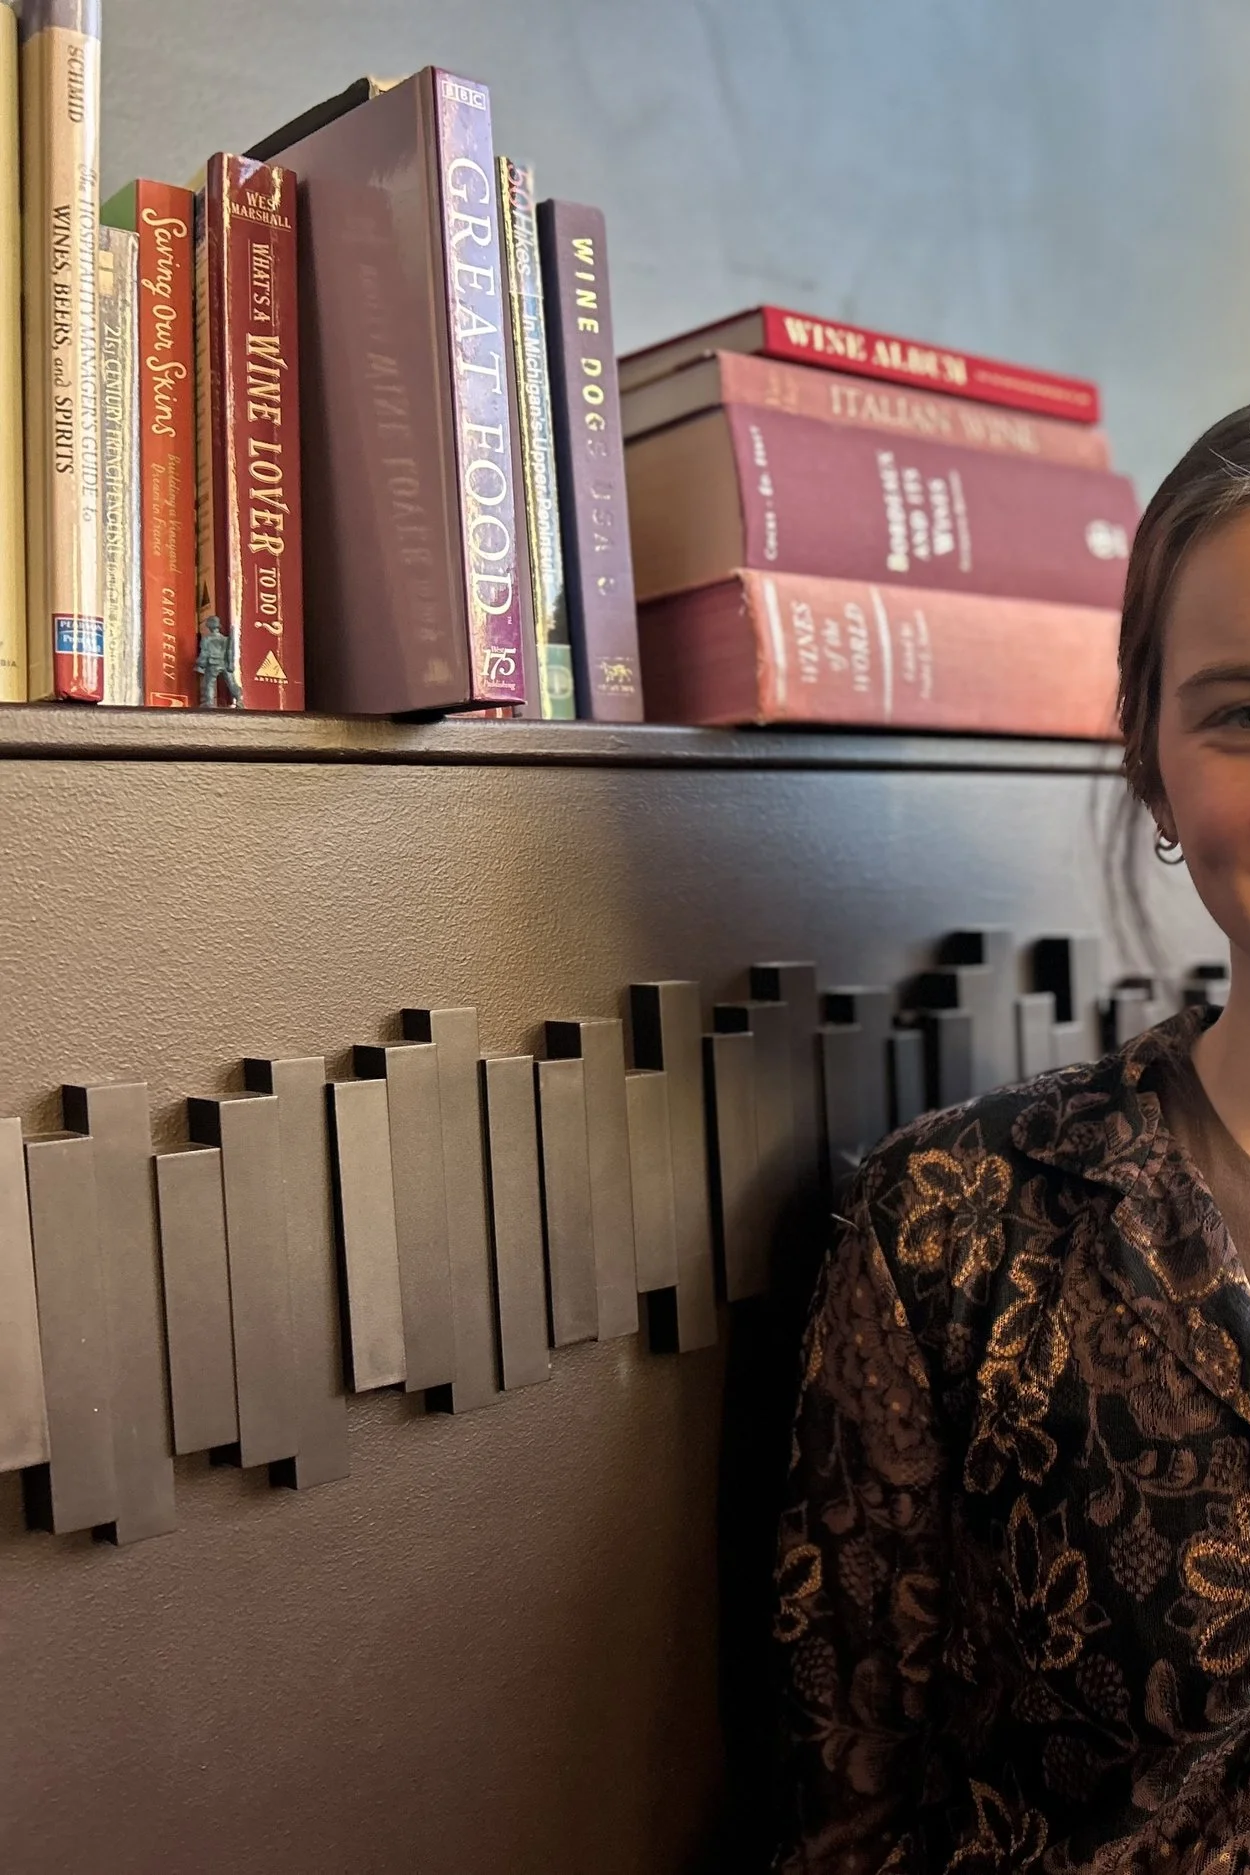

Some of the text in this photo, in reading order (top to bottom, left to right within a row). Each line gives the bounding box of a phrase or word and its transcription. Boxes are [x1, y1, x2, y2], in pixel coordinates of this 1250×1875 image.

[67, 44, 85, 124] SCHMID
[445, 82, 485, 108] BBC
[231, 202, 292, 229] MARSHALL
[508, 163, 534, 211] 50
[78, 199, 97, 322] HOSPITALITY
[252, 242, 272, 307] WHAT'S
[449, 157, 502, 394] GREAT
[511, 209, 537, 276] Hikes
[253, 310, 271, 323] A
[571, 237, 599, 335] WINE
[53, 204, 74, 474] WINES, BEERS, and SPIRITS
[141, 207, 187, 438] Saving Our Skins
[783, 315, 969, 386] WINE ALBUM
[79, 323, 98, 432] MANAGER'S
[104, 358, 122, 426] CENTURY
[246, 332, 288, 426] WINE
[523, 334, 546, 433] Michigan's
[580, 356, 608, 458] DOGS
[829, 383, 953, 435] ITALIAN
[957, 409, 1041, 454] WINE
[81, 436, 98, 497] GUIDE
[151, 463, 166, 501] Dream
[166, 453, 181, 511] Building
[247, 436, 291, 557] LOVER
[530, 436, 550, 493] Upper
[82, 506, 99, 522] to
[152, 516, 166, 556] France
[167, 519, 182, 574] Vineyard
[463, 419, 513, 615] FOOD
[259, 566, 277, 590] TO
[161, 587, 177, 681] CARO FEELY
[480, 648, 516, 680] 175
[790, 600, 819, 683] WINES
[844, 602, 871, 692] WORLD
